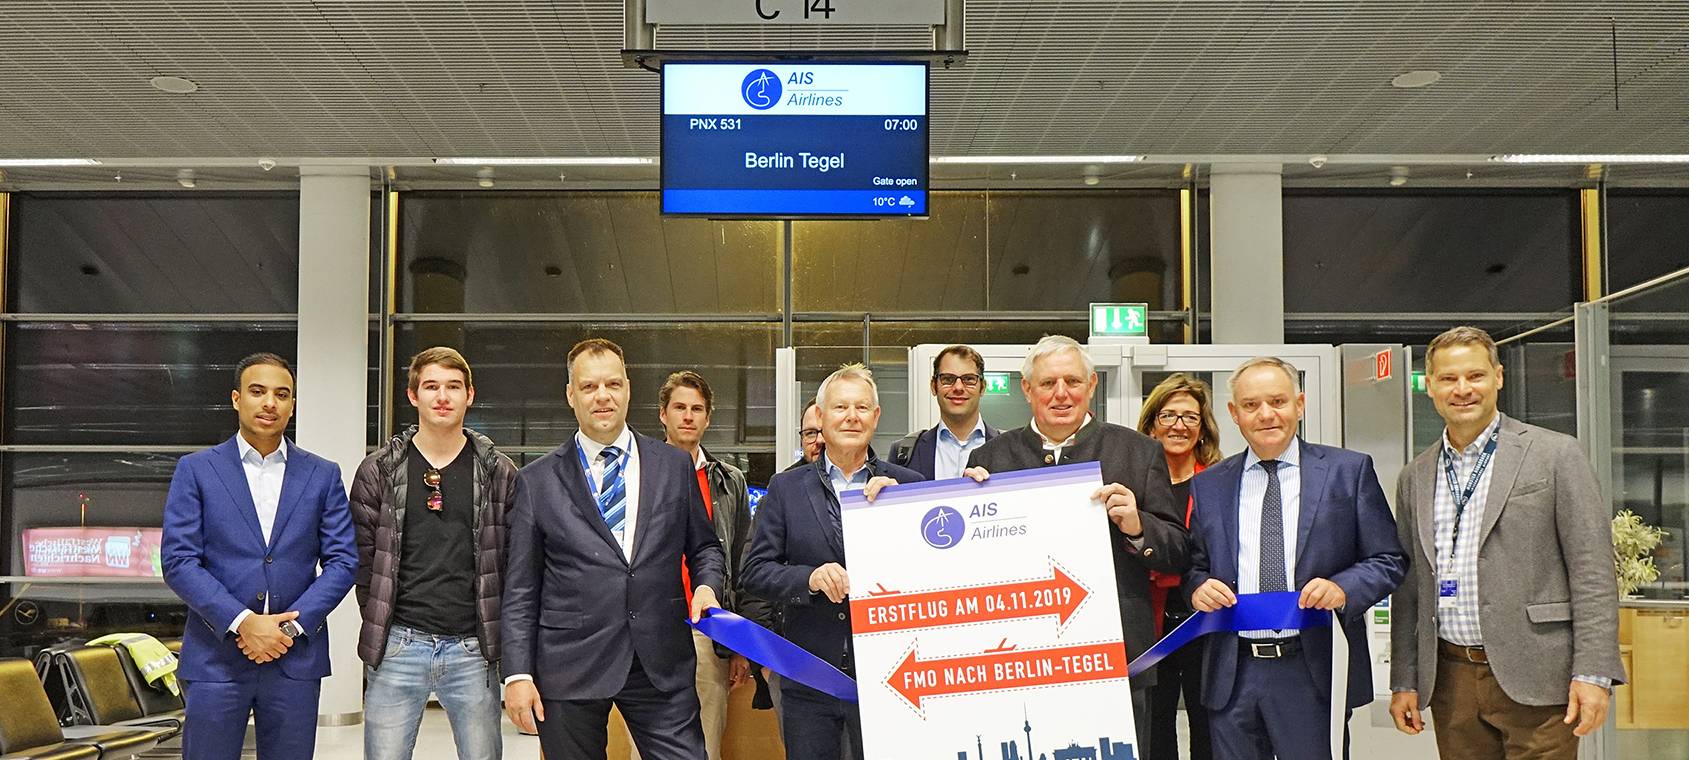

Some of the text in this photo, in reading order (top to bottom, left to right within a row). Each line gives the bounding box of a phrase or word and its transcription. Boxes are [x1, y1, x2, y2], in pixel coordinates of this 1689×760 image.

[755, 0, 836, 20] C 14
[787, 71, 814, 86] AIS
[787, 92, 843, 108] Airlines
[689, 118, 742, 131] PNX 531
[884, 119, 918, 131] 07:00
[745, 152, 845, 173] Berlin Tegel
[872, 176, 918, 188] Gate open
[872, 197, 896, 207] 10°C
[969, 502, 998, 519] AIS
[971, 523, 1027, 541] Airlines
[867, 586, 1072, 625] ERSTFLUG AM 04.11.2019
[903, 652, 1114, 690] FMO NACH BERLIN-TEGEL
